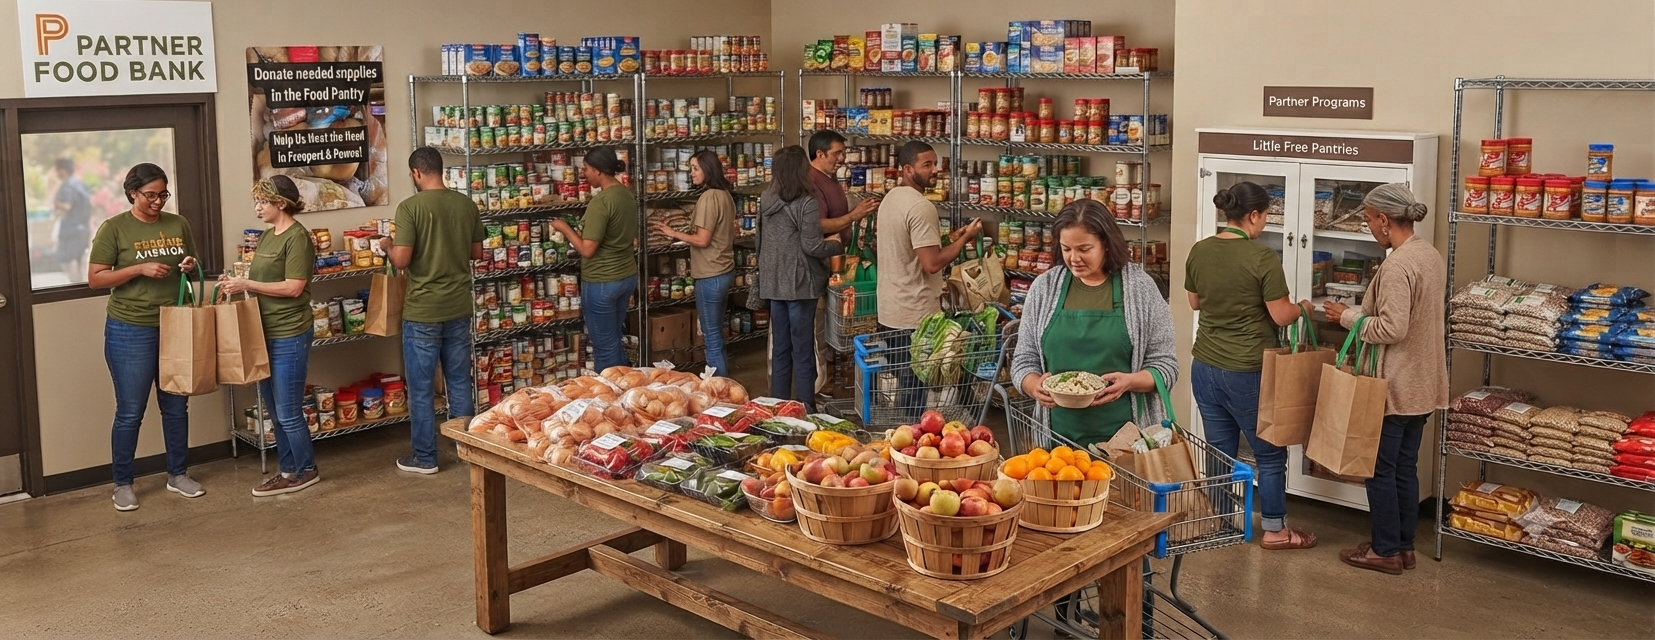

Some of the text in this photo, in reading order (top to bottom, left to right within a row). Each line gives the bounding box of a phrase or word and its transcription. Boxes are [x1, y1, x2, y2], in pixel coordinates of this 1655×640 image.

[76, 35, 203, 56] PARTNER
[34, 60, 205, 83] FOOD BANK
[254, 67, 293, 80] Donate
[296, 66, 334, 79] needed
[271, 88, 281, 101] in
[284, 87, 301, 100] the
[304, 87, 329, 100] Food
[1269, 96, 1366, 109] Partner Programs
[1253, 140, 1359, 155] Little Free Pantries
